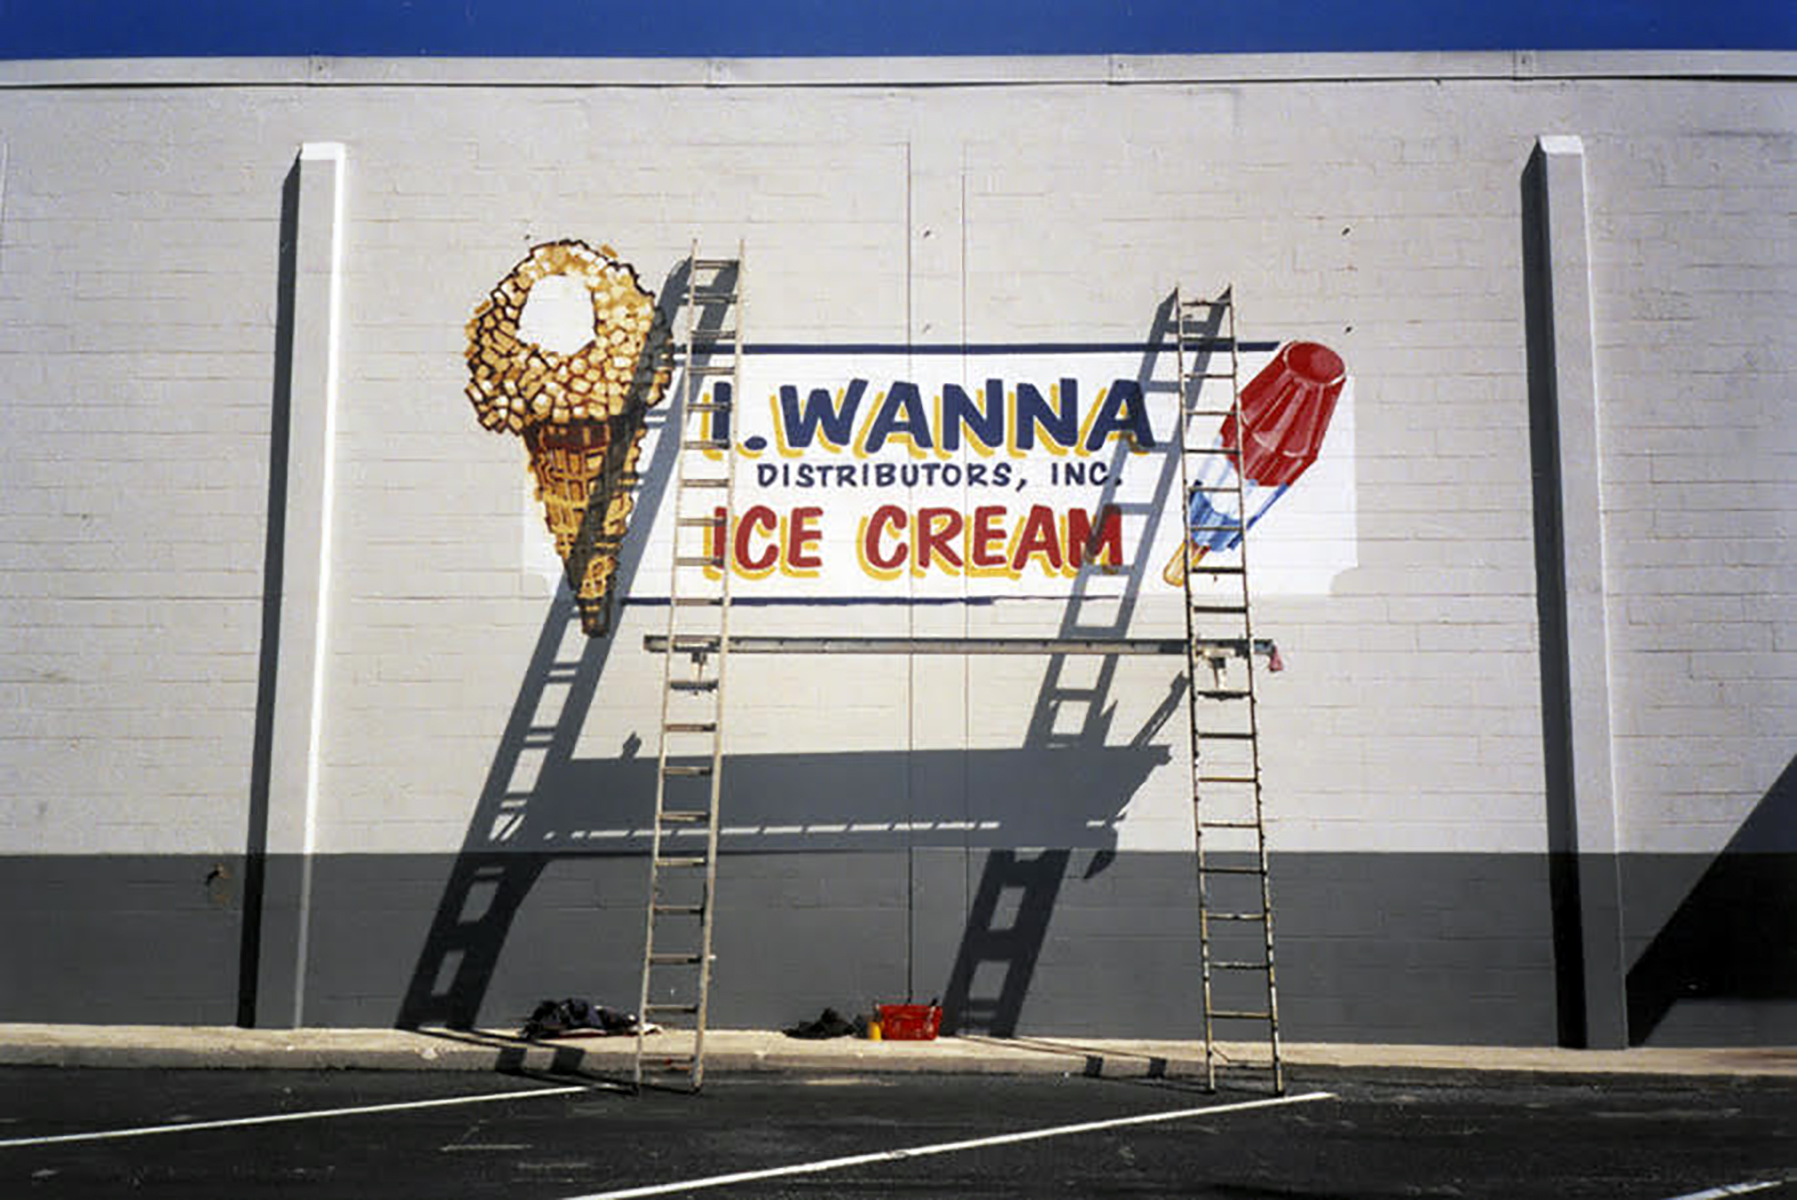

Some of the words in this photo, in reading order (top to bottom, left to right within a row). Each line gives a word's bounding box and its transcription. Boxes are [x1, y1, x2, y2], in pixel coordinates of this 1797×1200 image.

[757, 462, 1027, 492] DISTRIBUTORS,
[1051, 461, 1122, 487] INC.
[703, 504, 823, 581] ICE
[856, 503, 1123, 580] CREAM
